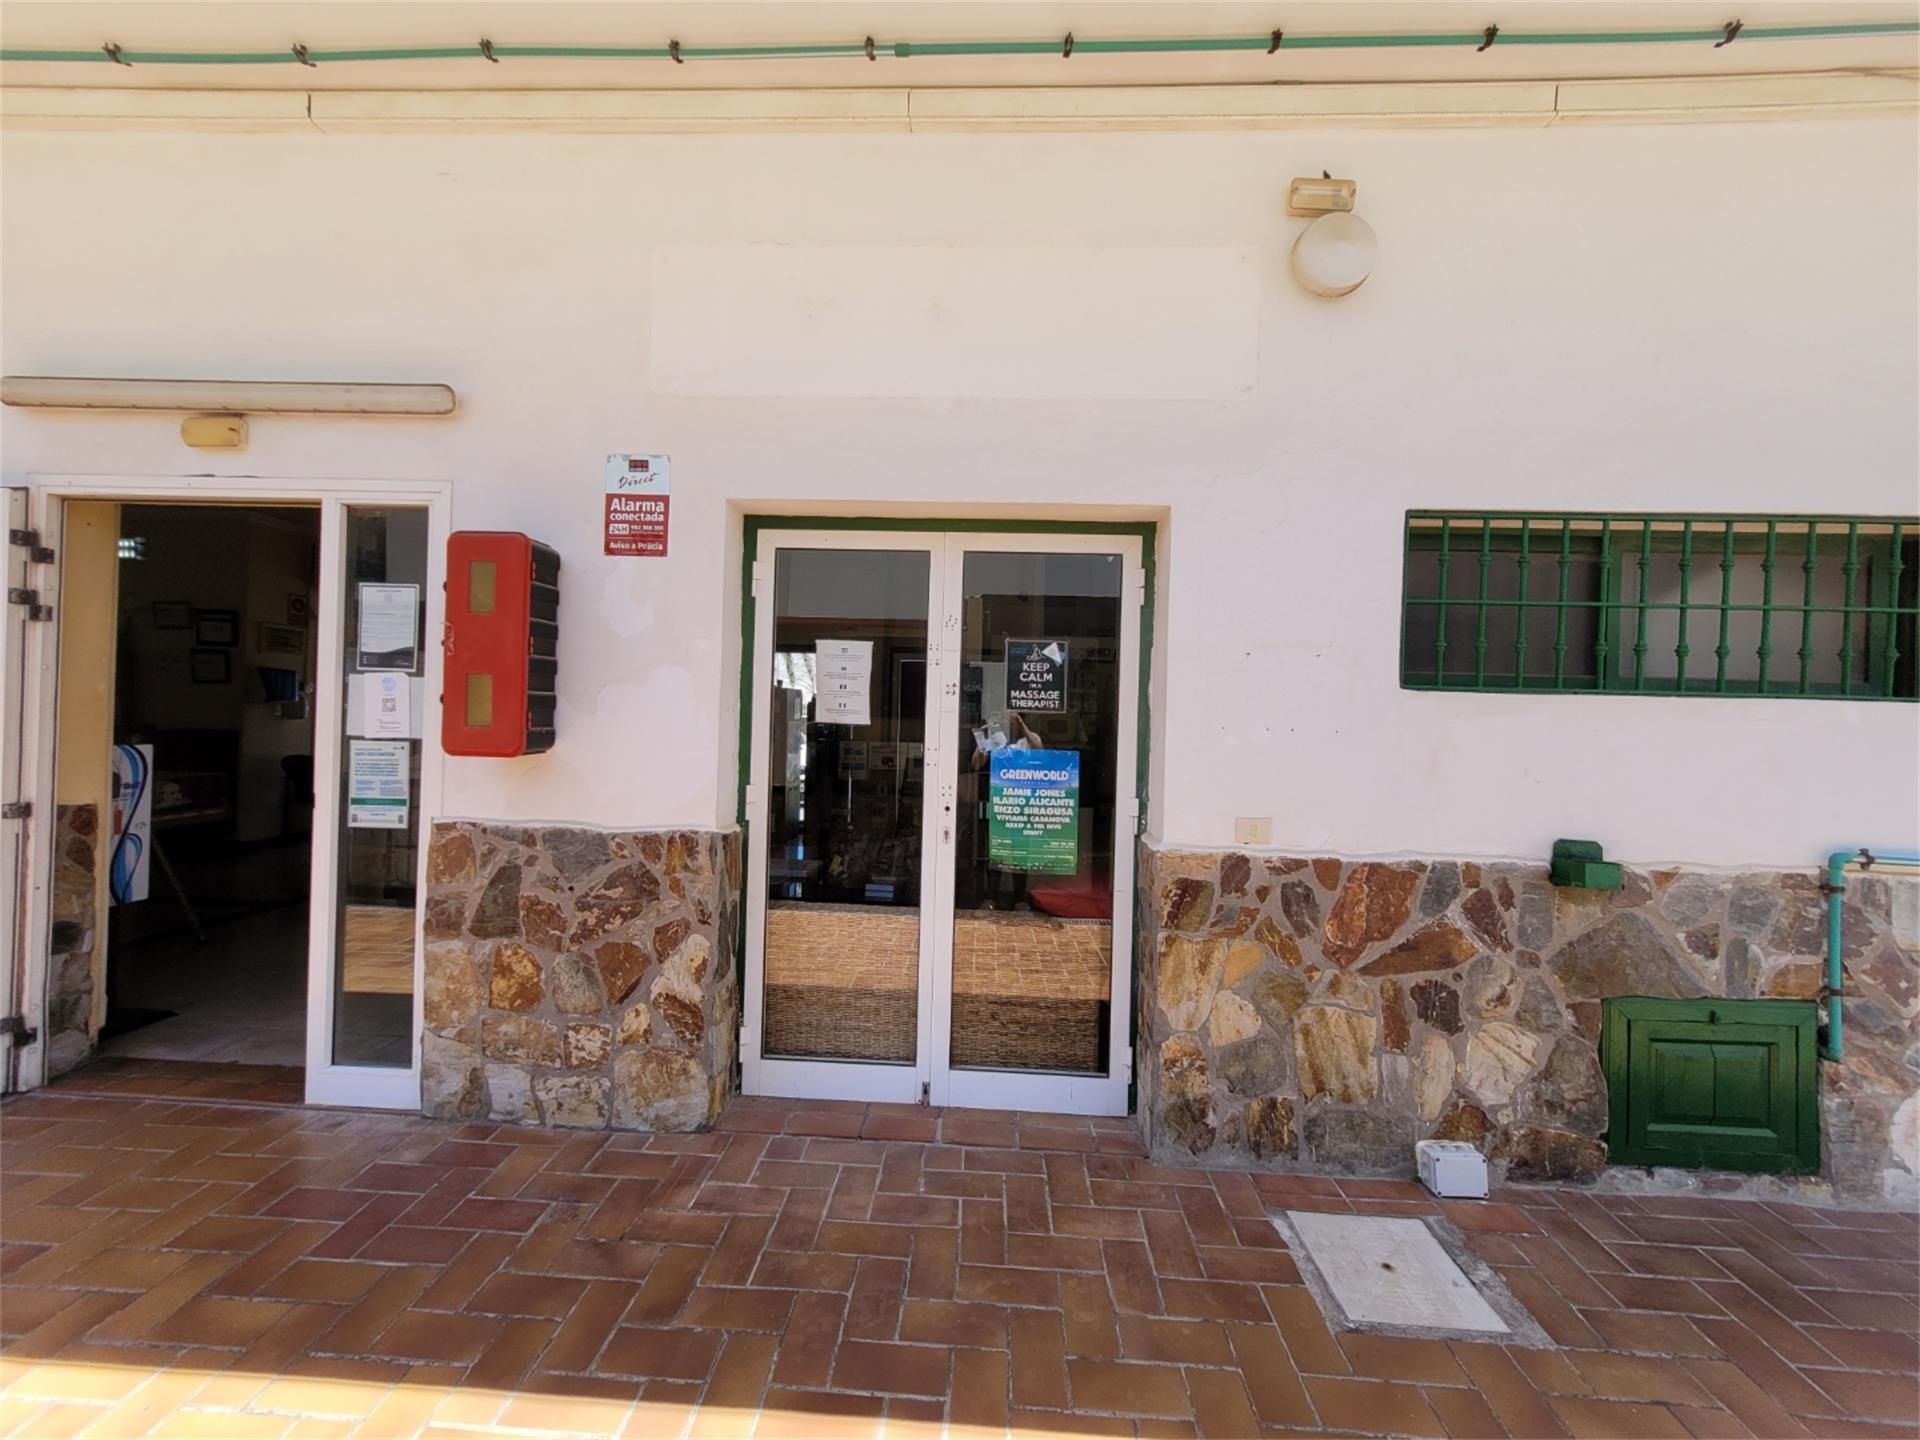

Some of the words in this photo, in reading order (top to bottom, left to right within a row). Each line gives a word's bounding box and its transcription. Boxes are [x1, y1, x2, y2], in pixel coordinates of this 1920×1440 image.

[610, 497, 665, 512] Alarma
[609, 511, 665, 521] conectada
[609, 541, 630, 549] Aviso
[1022, 662, 1051, 672] KEEP
[1019, 672, 1053, 682] CALM
[1010, 690, 1061, 700] MASSAGE
[1010, 700, 1060, 709] THERAPIST
[1000, 769, 1069, 781] GREENWORLD
[1002, 787, 1032, 796] JAMIE
[1034, 789, 1066, 798] JONES
[993, 796, 1026, 805] ILARIO
[1028, 798, 1075, 807] ALICANTE
[993, 805, 1021, 814] ENZO
[1023, 806, 1074, 816] SIRAGUSA
